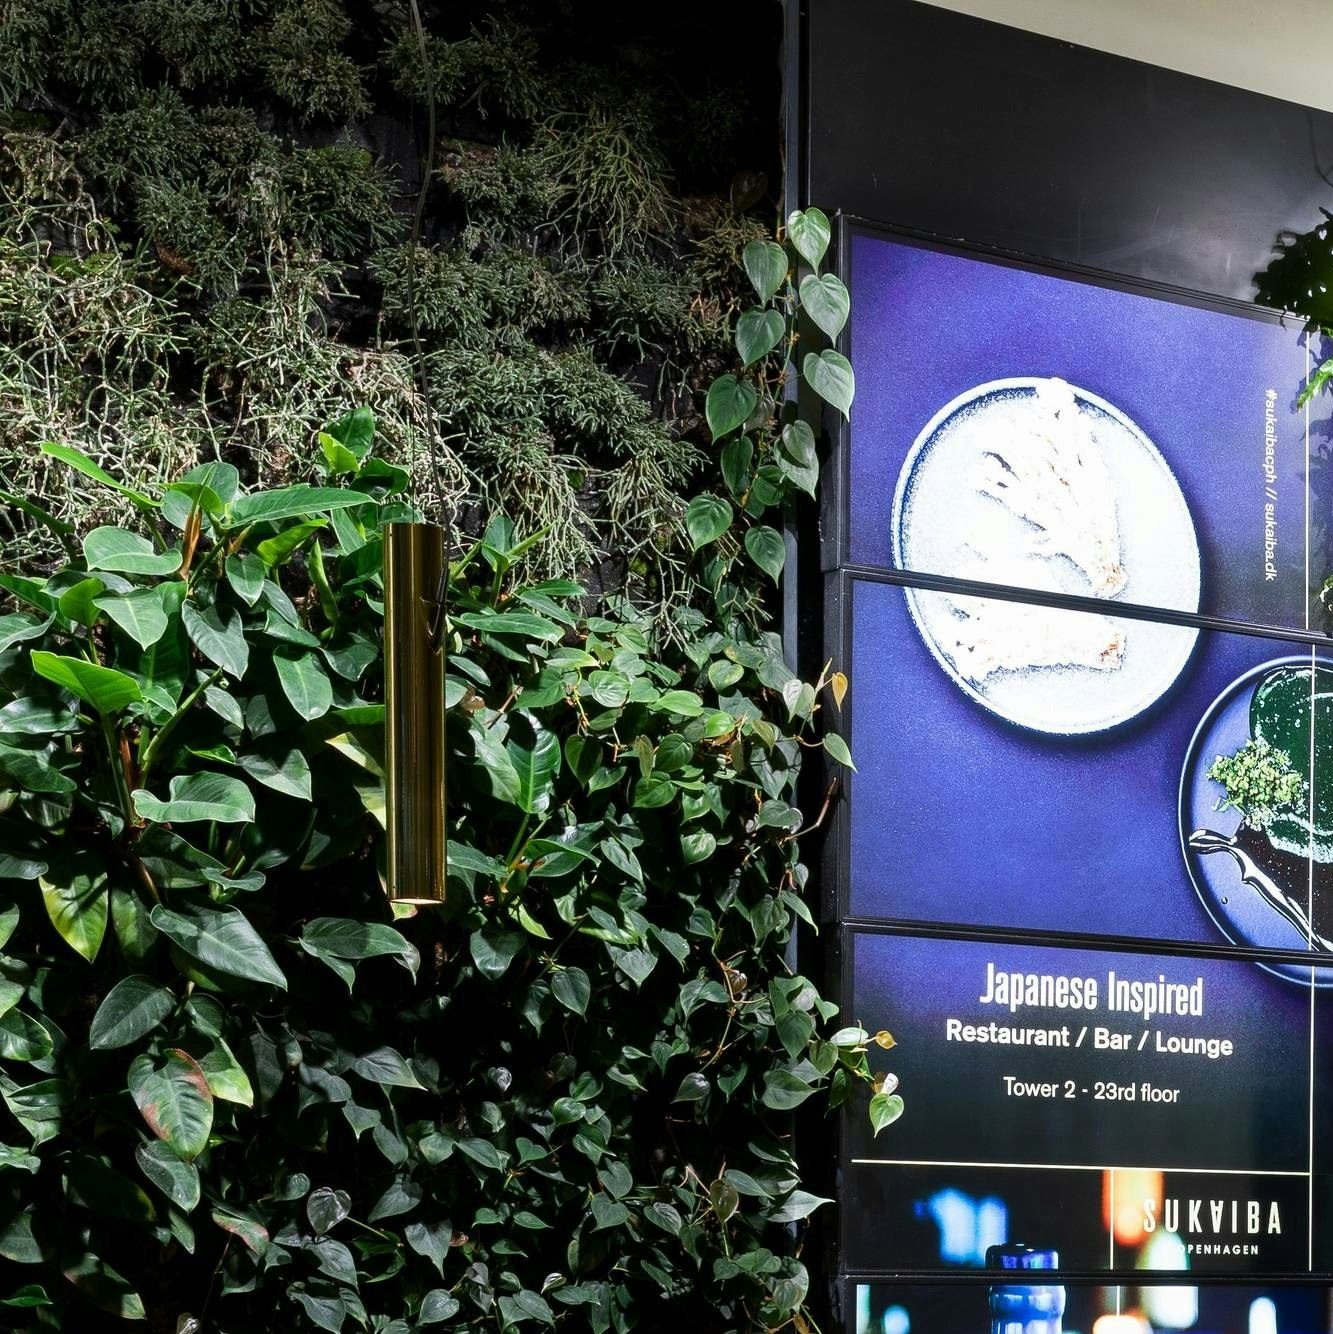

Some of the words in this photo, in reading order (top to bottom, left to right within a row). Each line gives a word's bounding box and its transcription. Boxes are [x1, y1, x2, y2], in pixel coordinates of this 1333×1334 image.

[1263, 388, 1278, 484] #sukaibacph
[1265, 486, 1278, 501] //
[1265, 502, 1278, 581] sukaiba.dk
[979, 962, 1098, 1013] Japanese
[1107, 971, 1204, 1021] Inspired
[946, 1018, 1070, 1047] Restaurant
[1075, 1026, 1088, 1048] /
[1094, 1027, 1133, 1050] Bar
[1137, 1030, 1150, 1051] /
[1155, 1031, 1234, 1059] Lounge
[1003, 1076, 1060, 1098] Tower
[1064, 1080, 1076, 1098] 2
[1093, 1081, 1136, 1102] 23rd
[1140, 1082, 1181, 1103] floor
[1180, 1244, 1259, 1255] PENHAGEN
